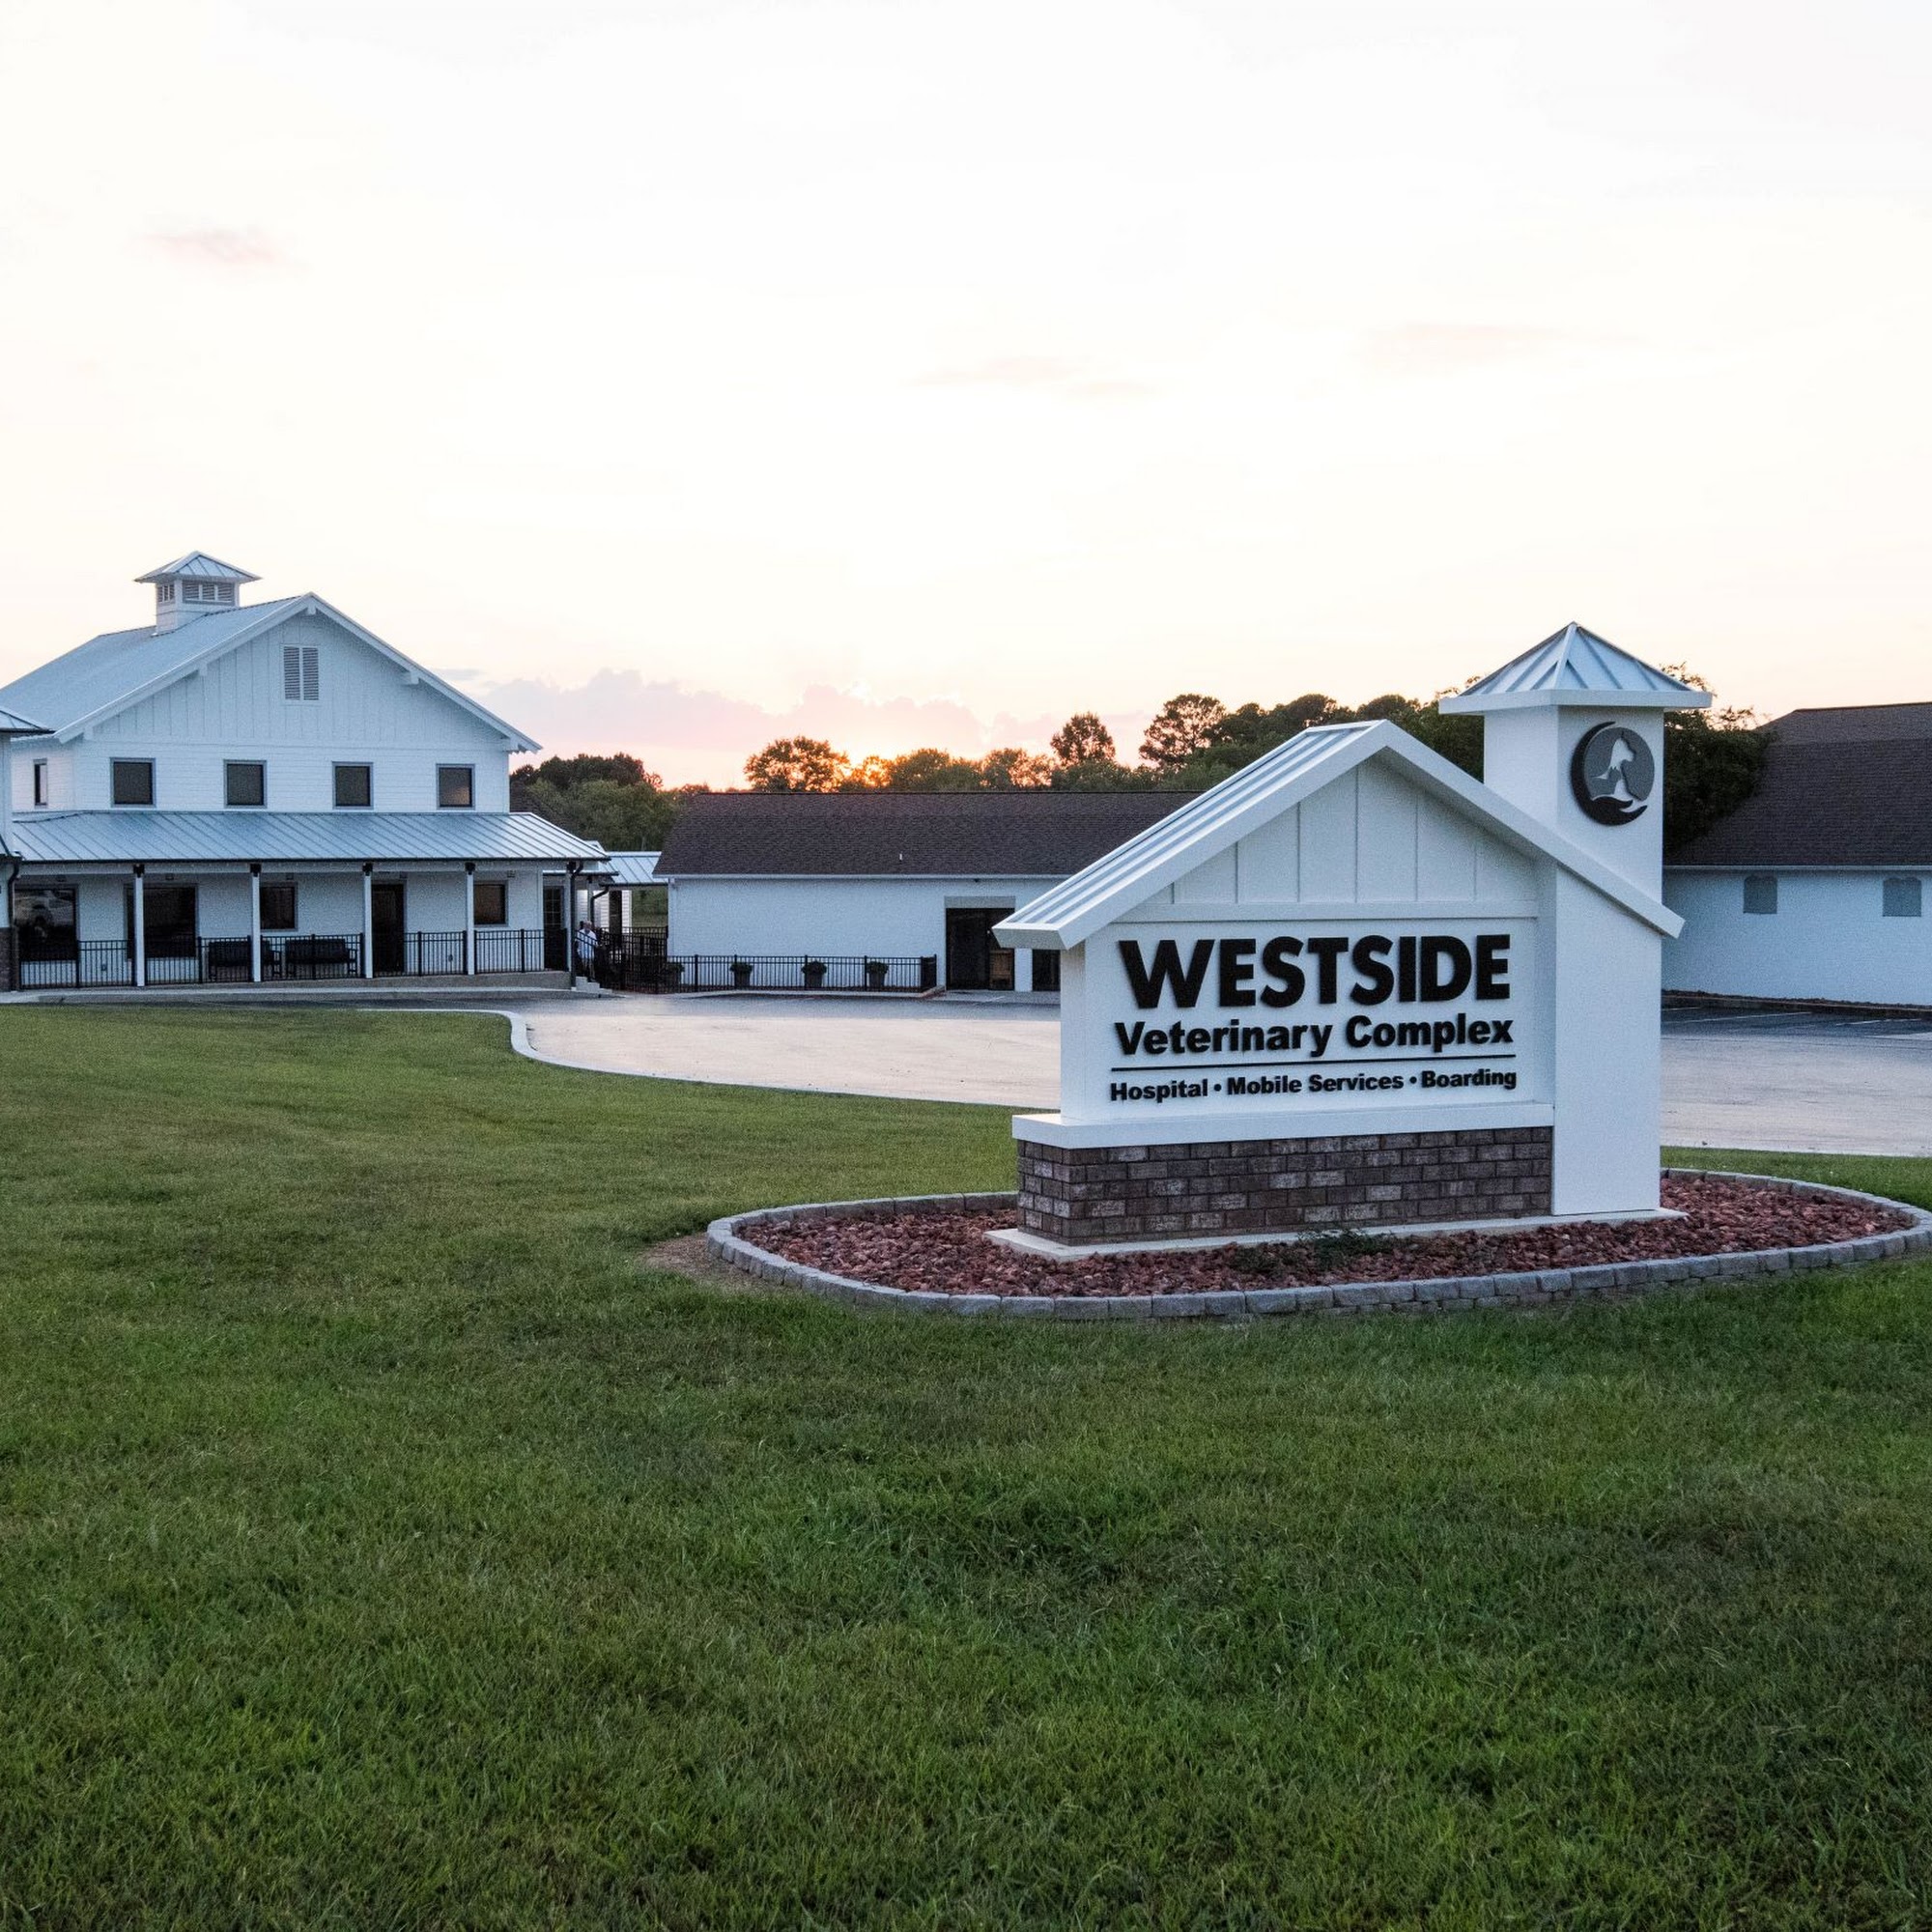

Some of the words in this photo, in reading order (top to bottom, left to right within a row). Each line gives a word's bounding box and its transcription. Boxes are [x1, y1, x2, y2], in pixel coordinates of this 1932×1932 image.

[1118, 933, 1512, 1009] WESTSIDE
[1114, 1018, 1334, 1057] Veterinary
[1346, 1012, 1514, 1053] Complex
[1110, 1078, 1208, 1103] Hospital
[1227, 1075, 1302, 1095] Mobile
[1308, 1073, 1405, 1094] Services
[1421, 1068, 1517, 1091] Boarding
